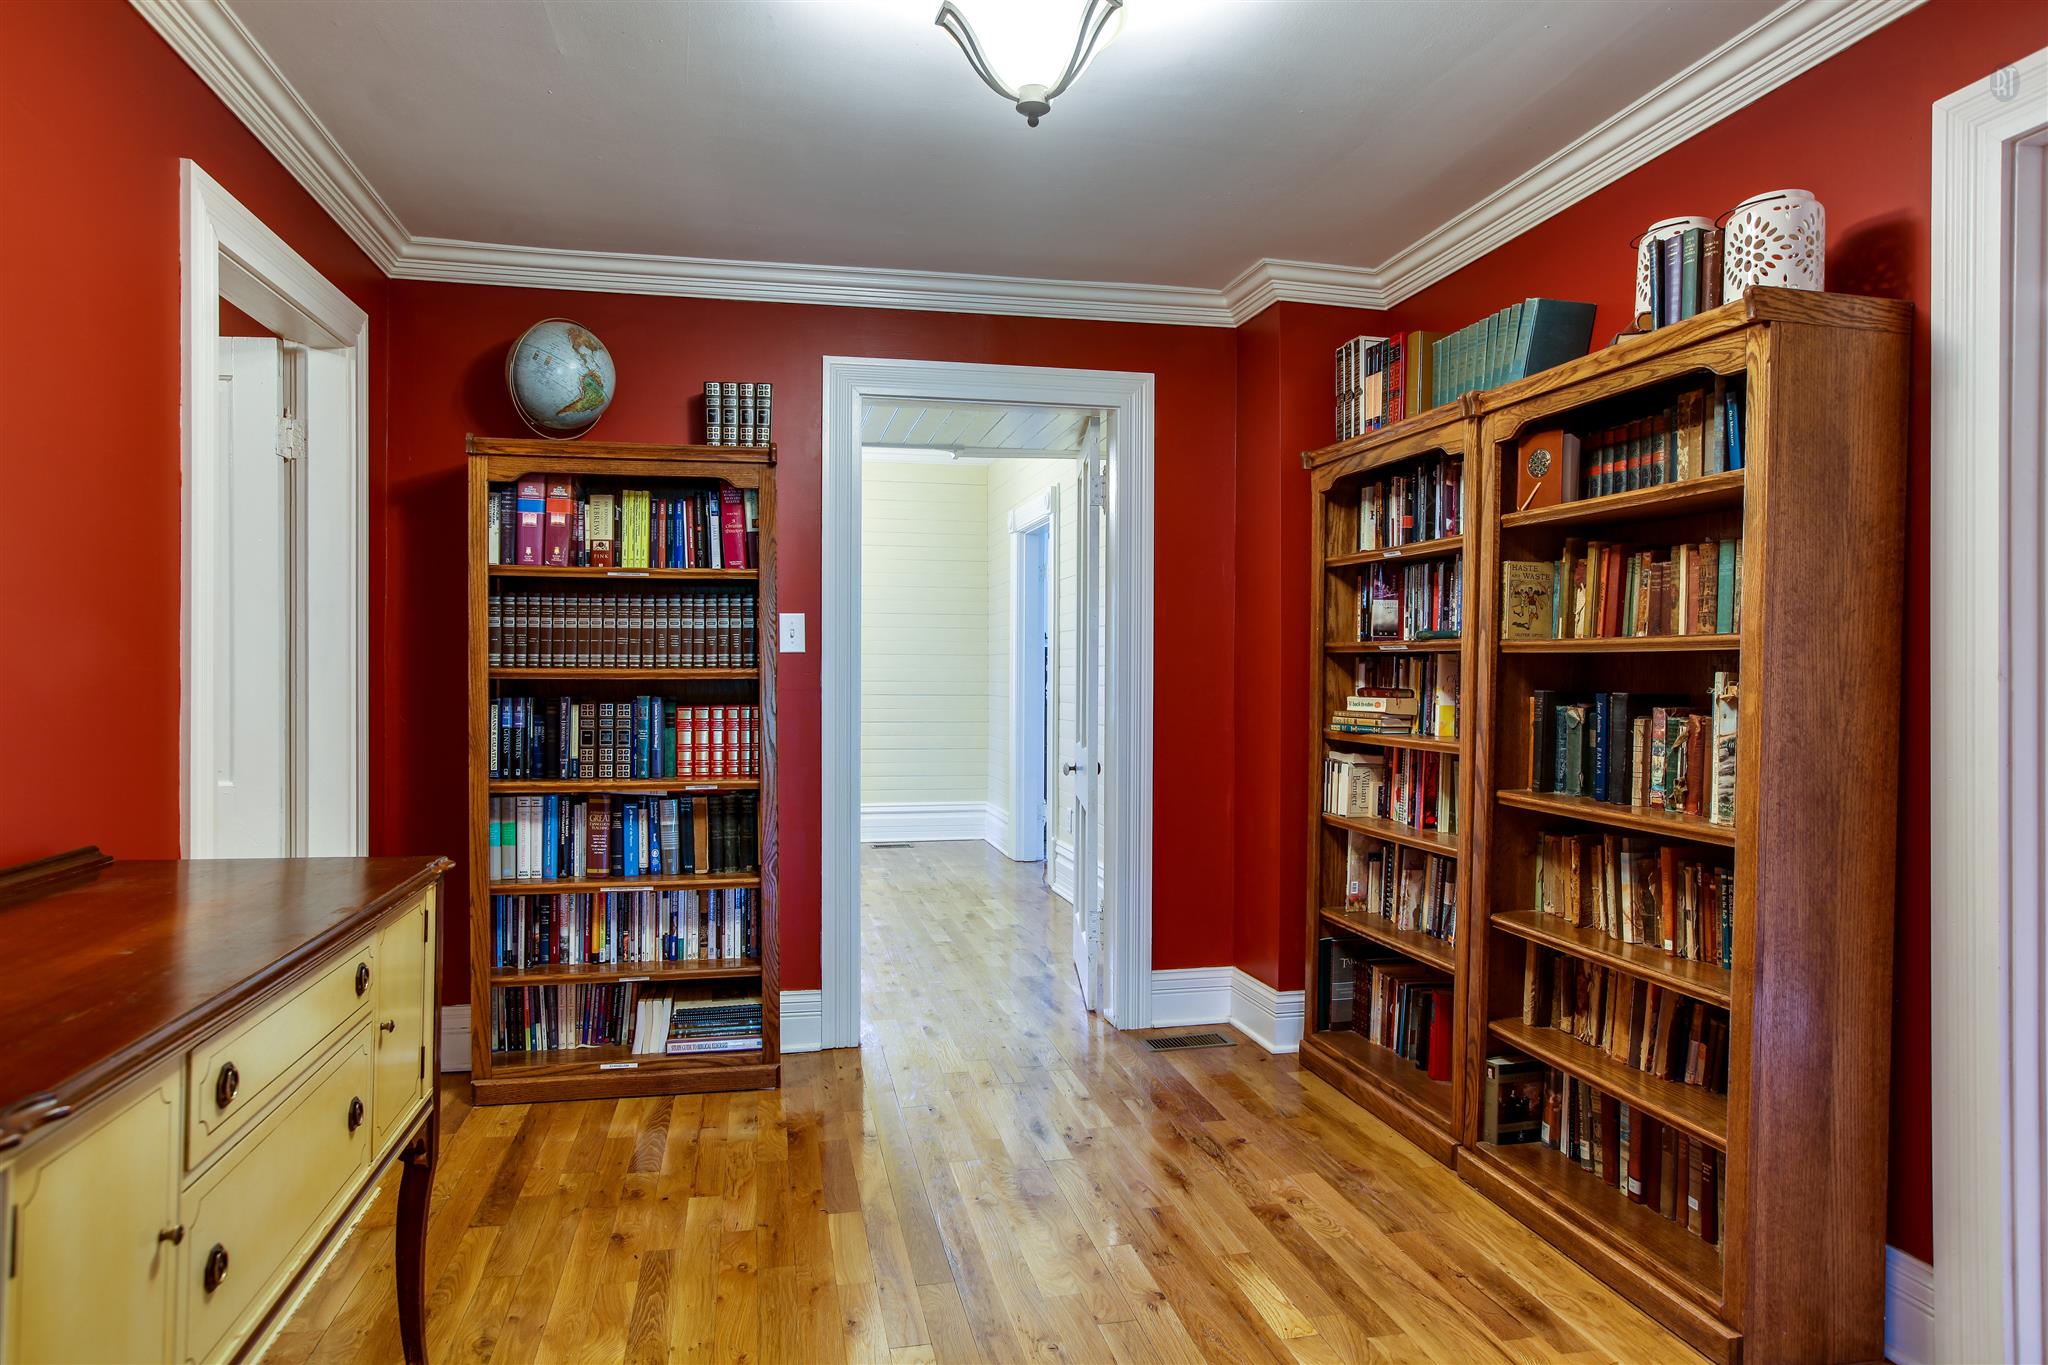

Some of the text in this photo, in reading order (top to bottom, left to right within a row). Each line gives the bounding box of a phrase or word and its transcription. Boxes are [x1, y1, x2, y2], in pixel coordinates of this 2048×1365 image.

[1512, 564, 1538, 572] HASTE
[1522, 572, 1551, 580] WASTE
[1352, 775, 1360, 806] Bennett
[1361, 770, 1370, 803] William
[590, 814, 610, 822] GREAT
